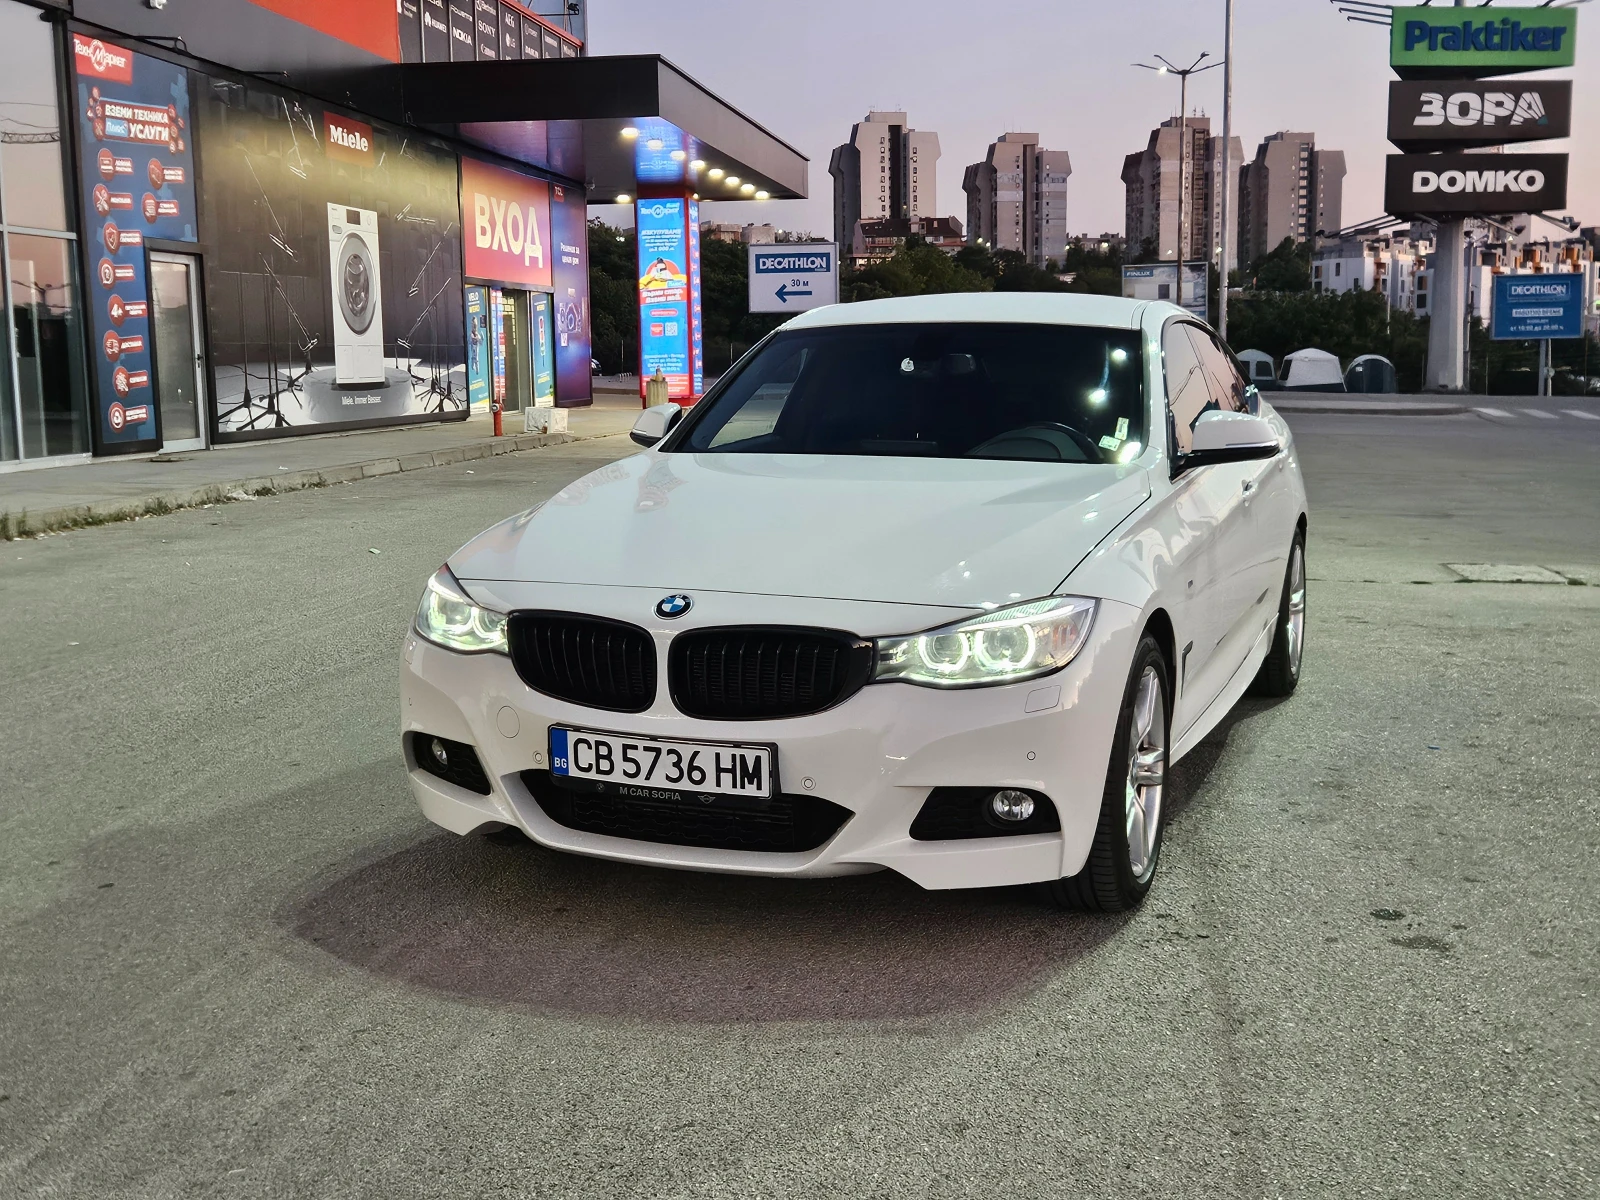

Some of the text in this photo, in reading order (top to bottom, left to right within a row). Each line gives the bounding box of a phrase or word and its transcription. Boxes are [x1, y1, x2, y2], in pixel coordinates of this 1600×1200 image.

[478, 20, 496, 38] SONY
[505, 12, 515, 28] AEG
[452, 26, 473, 46] NOKIA
[1405, 17, 1567, 51] Praktiker
[105, 104, 169, 124] ВЗЕМИ ТЕХНИКА
[129, 123, 169, 141] УСЛУГИ
[330, 124, 368, 152] Miele
[1412, 169, 1545, 193] DOMKO
[554, 186, 564, 197] TCL
[474, 192, 543, 268] ВХОД
[759, 256, 827, 270] DECATHLON
[791, 278, 801, 287] 30
[1511, 284, 1567, 295] DECATHLON
[554, 756, 568, 769] BG
[621, 743, 707, 786] 5736
[619, 786, 681, 801] M CAR SOFIA
